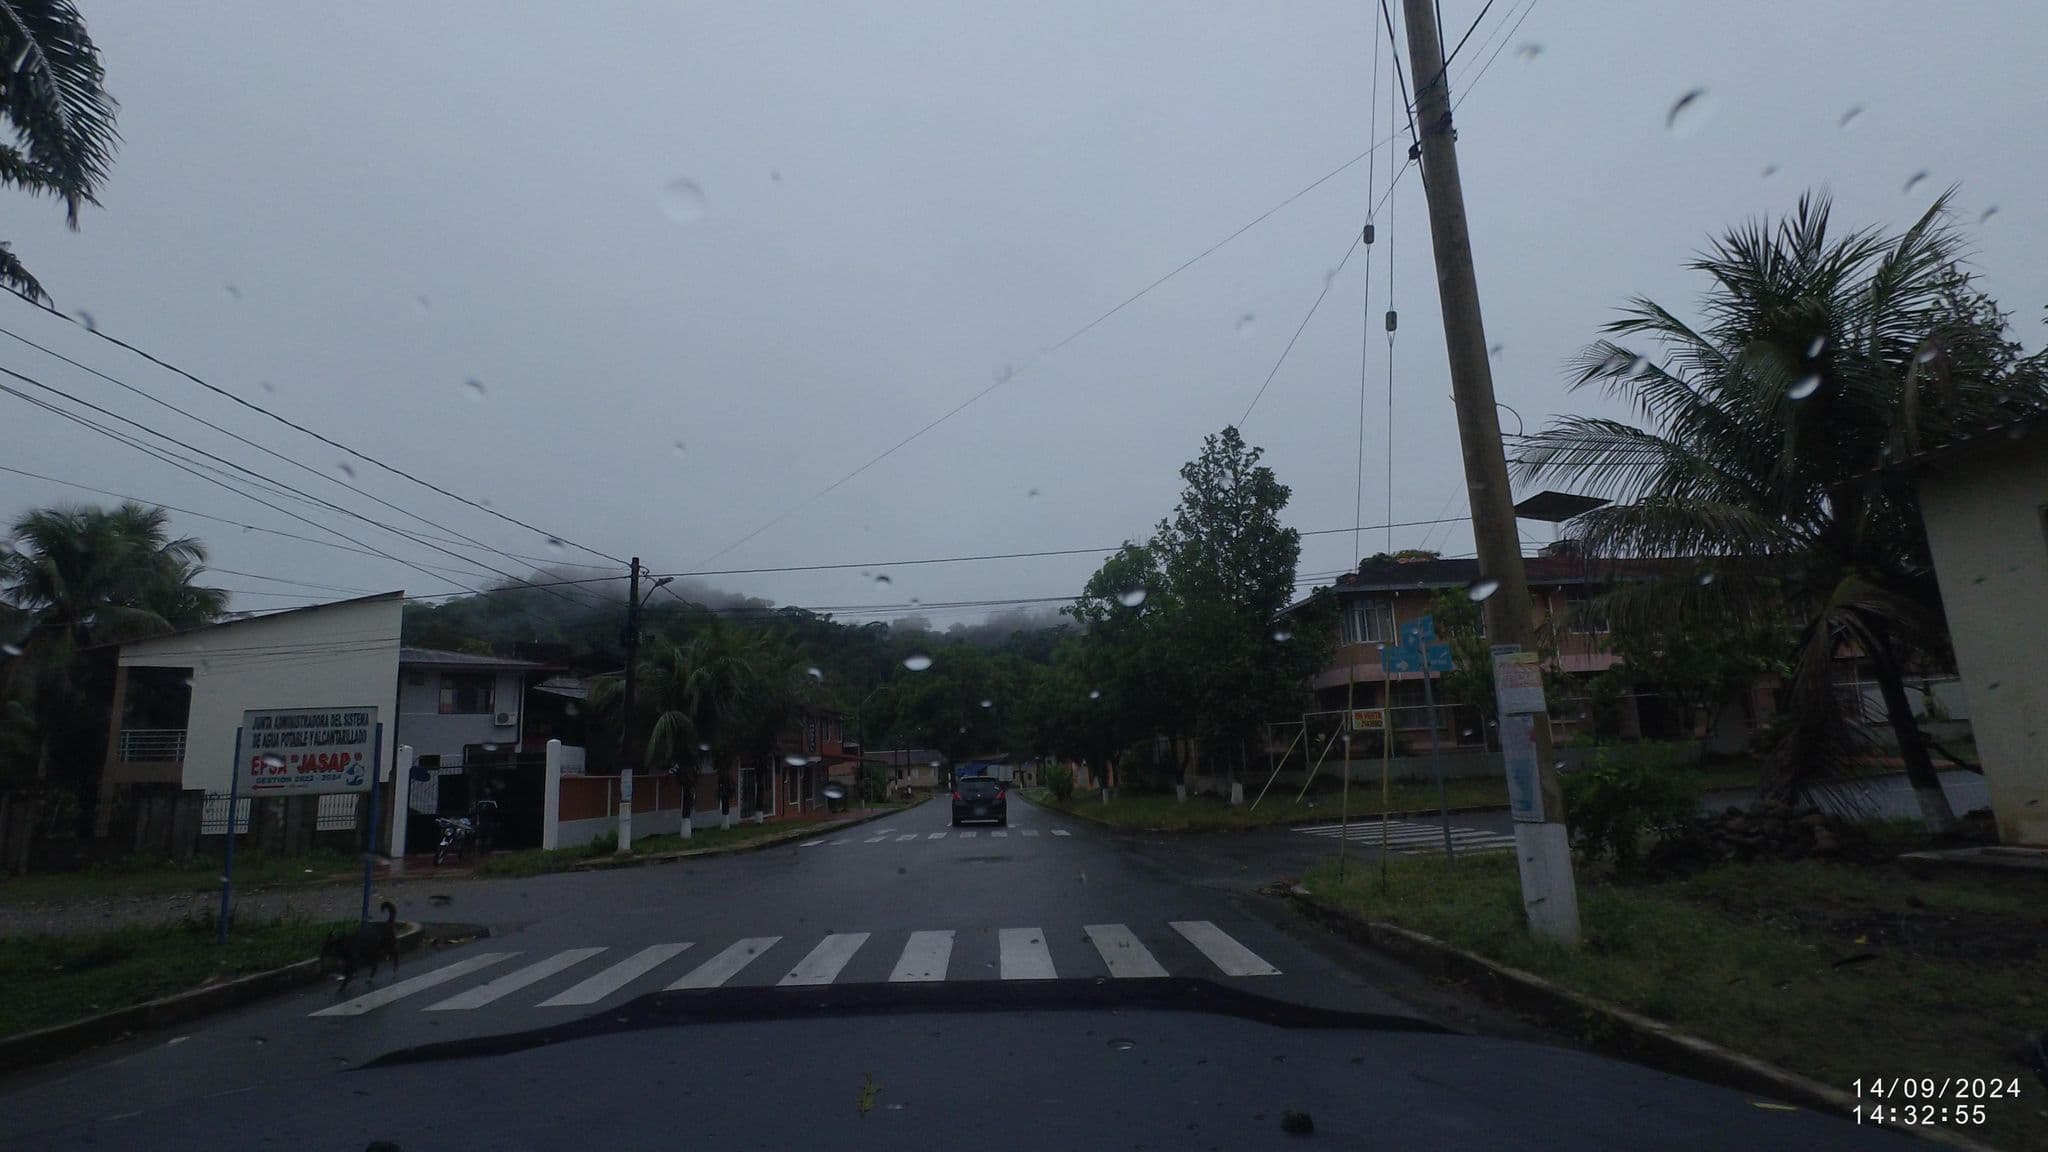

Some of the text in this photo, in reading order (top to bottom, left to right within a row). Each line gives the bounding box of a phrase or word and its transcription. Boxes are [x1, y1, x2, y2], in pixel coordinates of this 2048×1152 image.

[252, 713, 369, 730] JUNTA ADMINISTRADORA DEL SISTEMA
[252, 732, 261, 748] DE
[262, 731, 279, 748] AGUA
[280, 730, 307, 747] POTABLE
